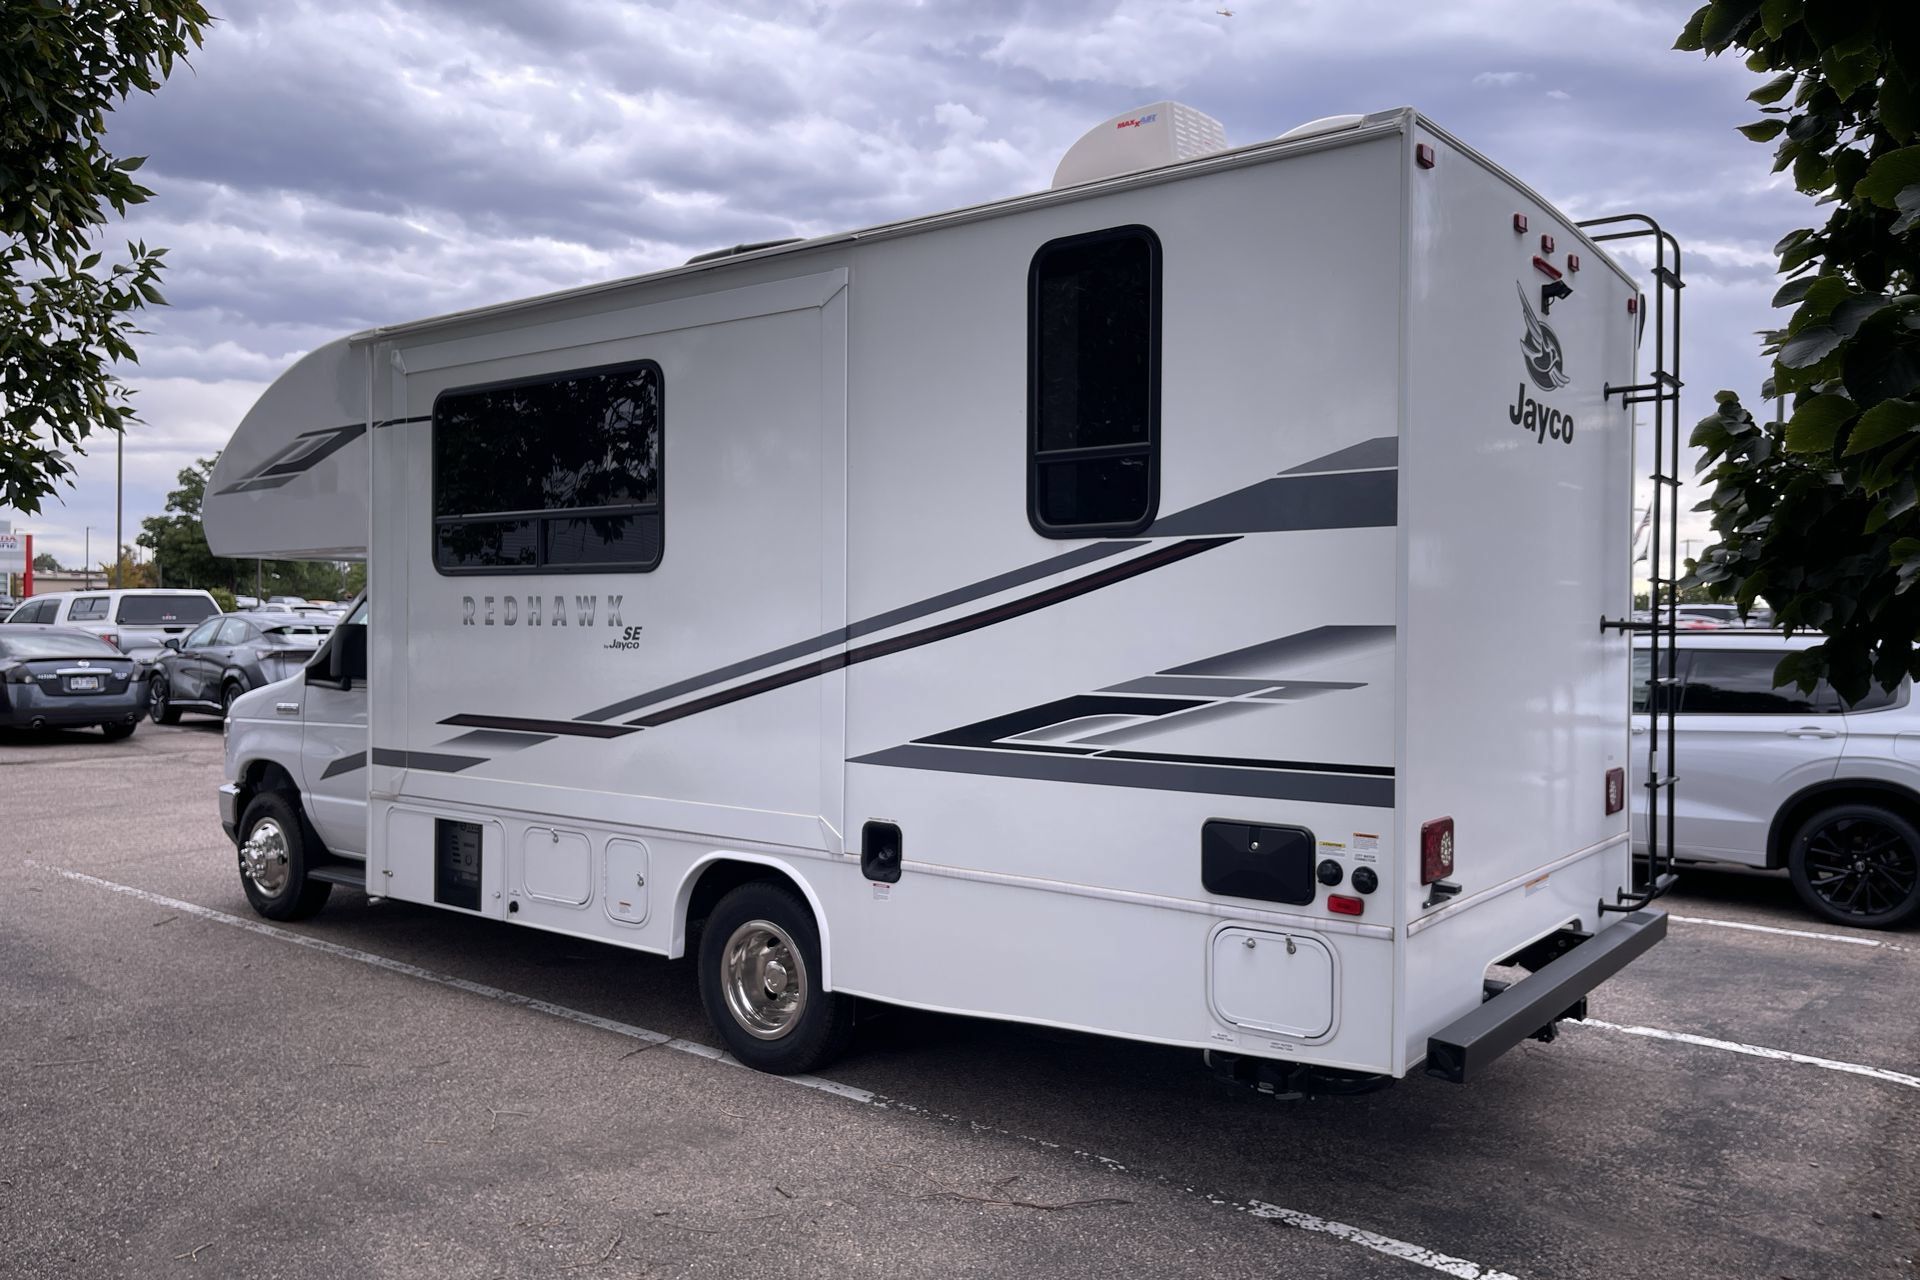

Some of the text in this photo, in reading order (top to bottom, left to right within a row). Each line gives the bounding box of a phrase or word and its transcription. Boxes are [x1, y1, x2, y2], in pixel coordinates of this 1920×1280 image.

[1509, 382, 1574, 445] Jayco
[462, 595, 624, 627] REDHAWK
[609, 638, 640, 651] Jayco
[622, 626, 643, 641] SE
